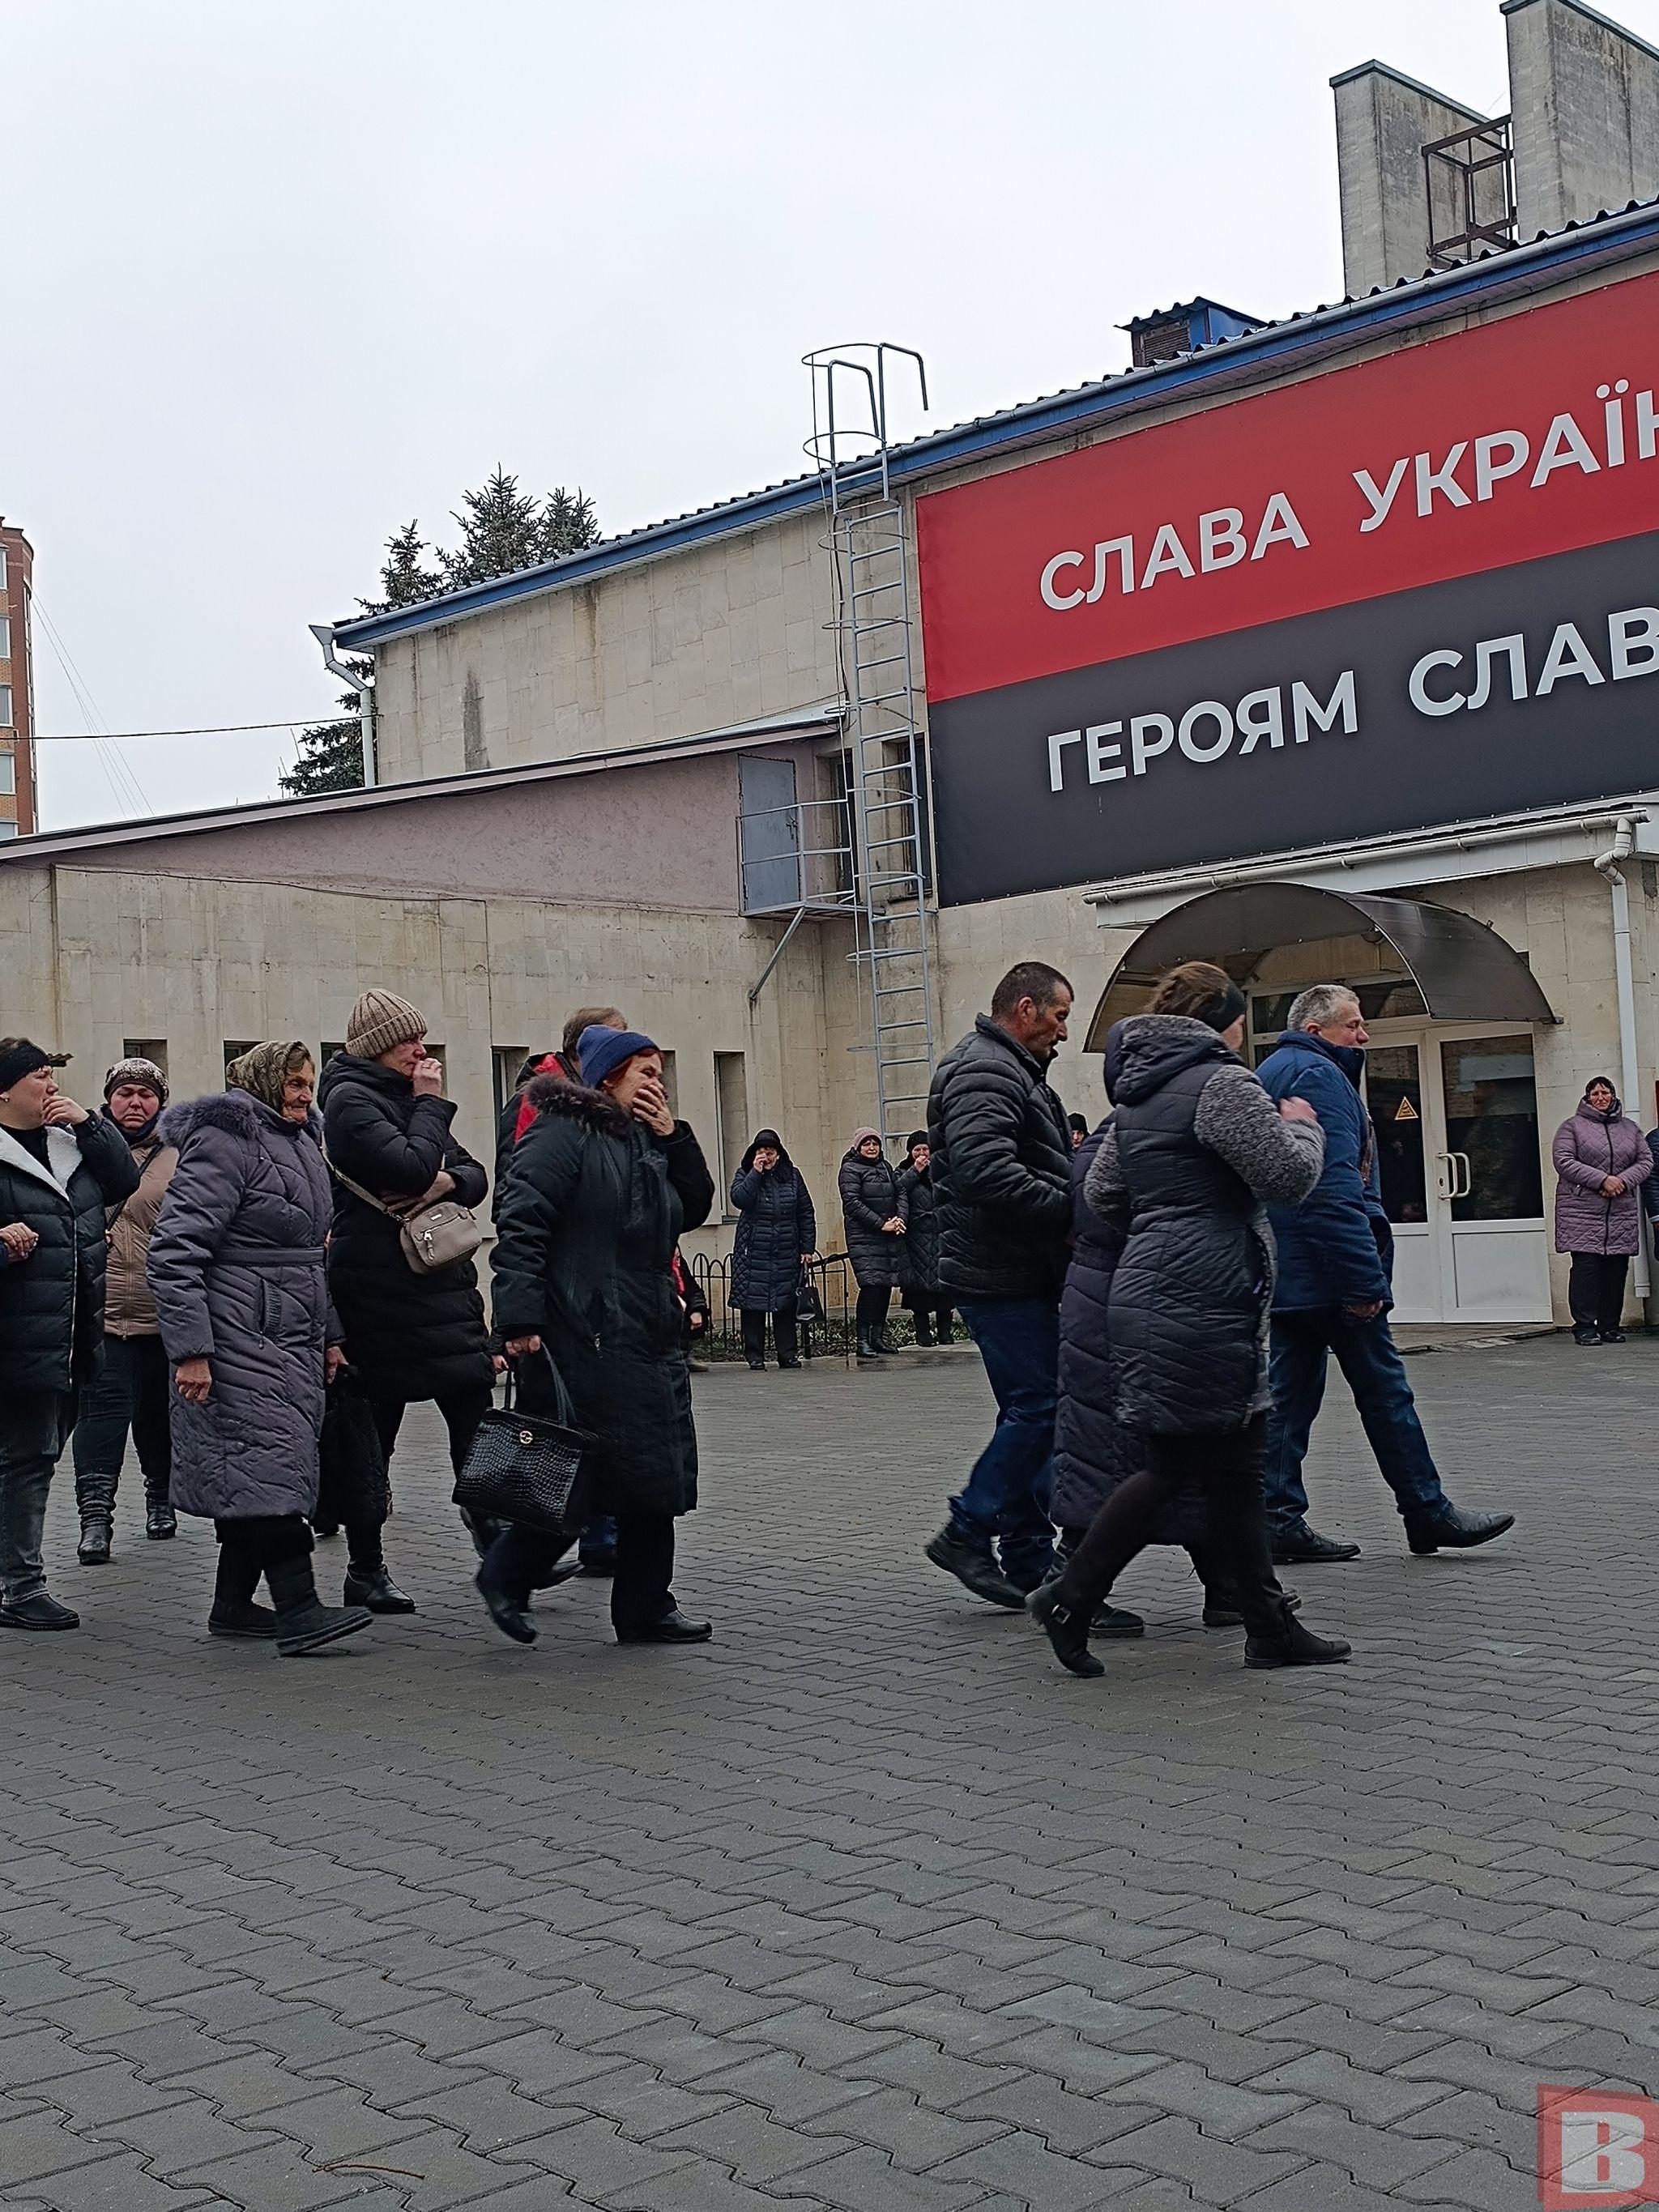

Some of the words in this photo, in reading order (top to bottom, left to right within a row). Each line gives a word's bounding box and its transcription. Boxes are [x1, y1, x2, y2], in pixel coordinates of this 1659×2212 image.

[1039, 491, 1311, 612] СЛАВА
[1047, 669, 1359, 793] ГЕРОЯМ
[1408, 606, 1659, 717] СЛАВ
